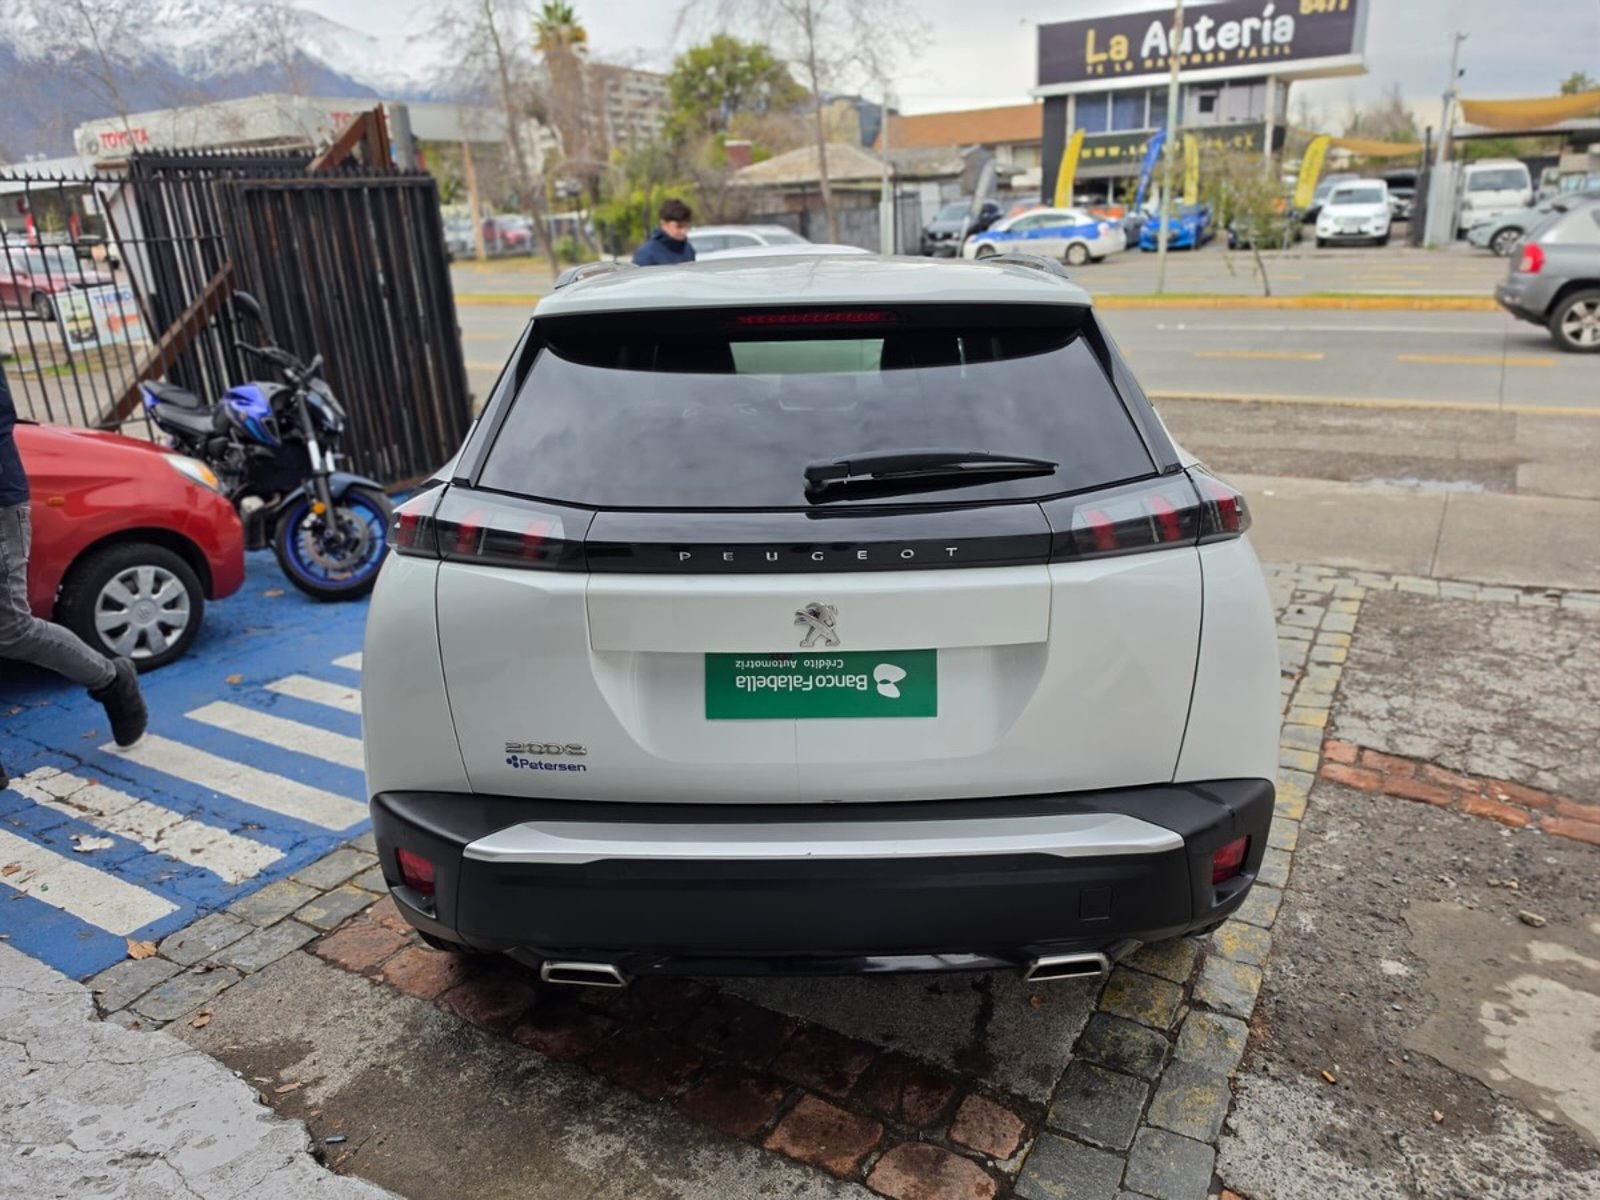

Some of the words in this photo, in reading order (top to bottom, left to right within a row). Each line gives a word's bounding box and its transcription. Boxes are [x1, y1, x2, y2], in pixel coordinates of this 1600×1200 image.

[1086, 28, 1129, 63] La
[1141, 3, 1295, 58] Autería
[100, 128, 149, 148] TOYOTA
[679, 547, 958, 562] PEUGEOT
[735, 659, 798, 669] Automotriz
[803, 659, 844, 669] Crédito
[504, 742, 588, 756] 2008
[519, 758, 587, 772] Petersen
